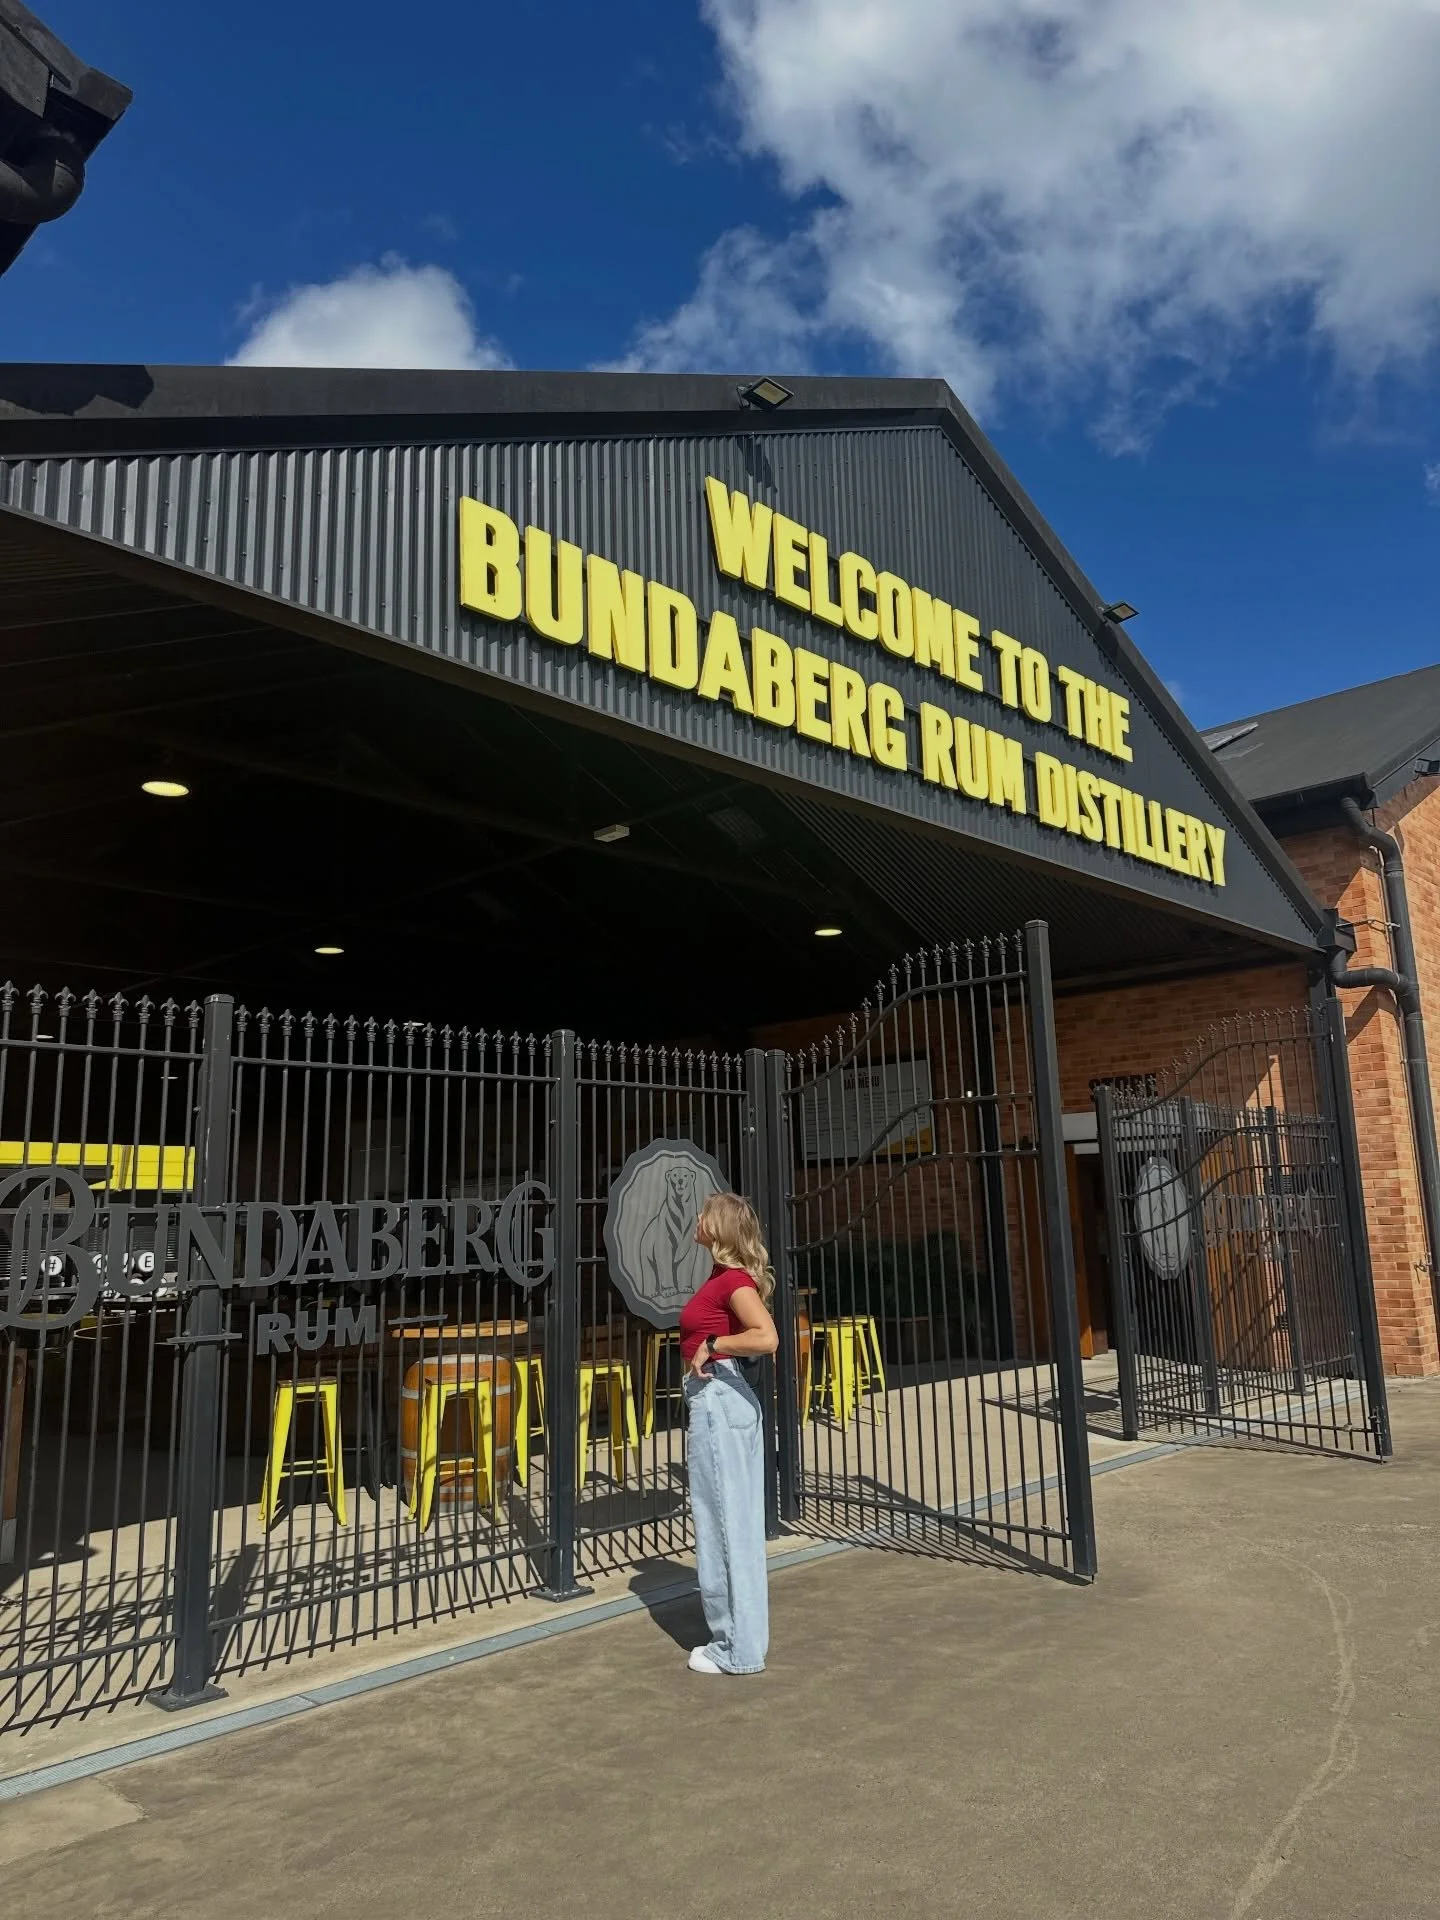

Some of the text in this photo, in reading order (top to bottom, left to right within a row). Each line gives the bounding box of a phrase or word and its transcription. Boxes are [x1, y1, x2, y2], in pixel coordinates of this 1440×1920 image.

[460, 495, 1226, 887] BUNDABERG RUM DISTILLERY
[705, 476, 1134, 763] WELCOME TO THE
[0, 1166, 556, 1330] BUNDABERG
[257, 1304, 378, 1356] RUM
